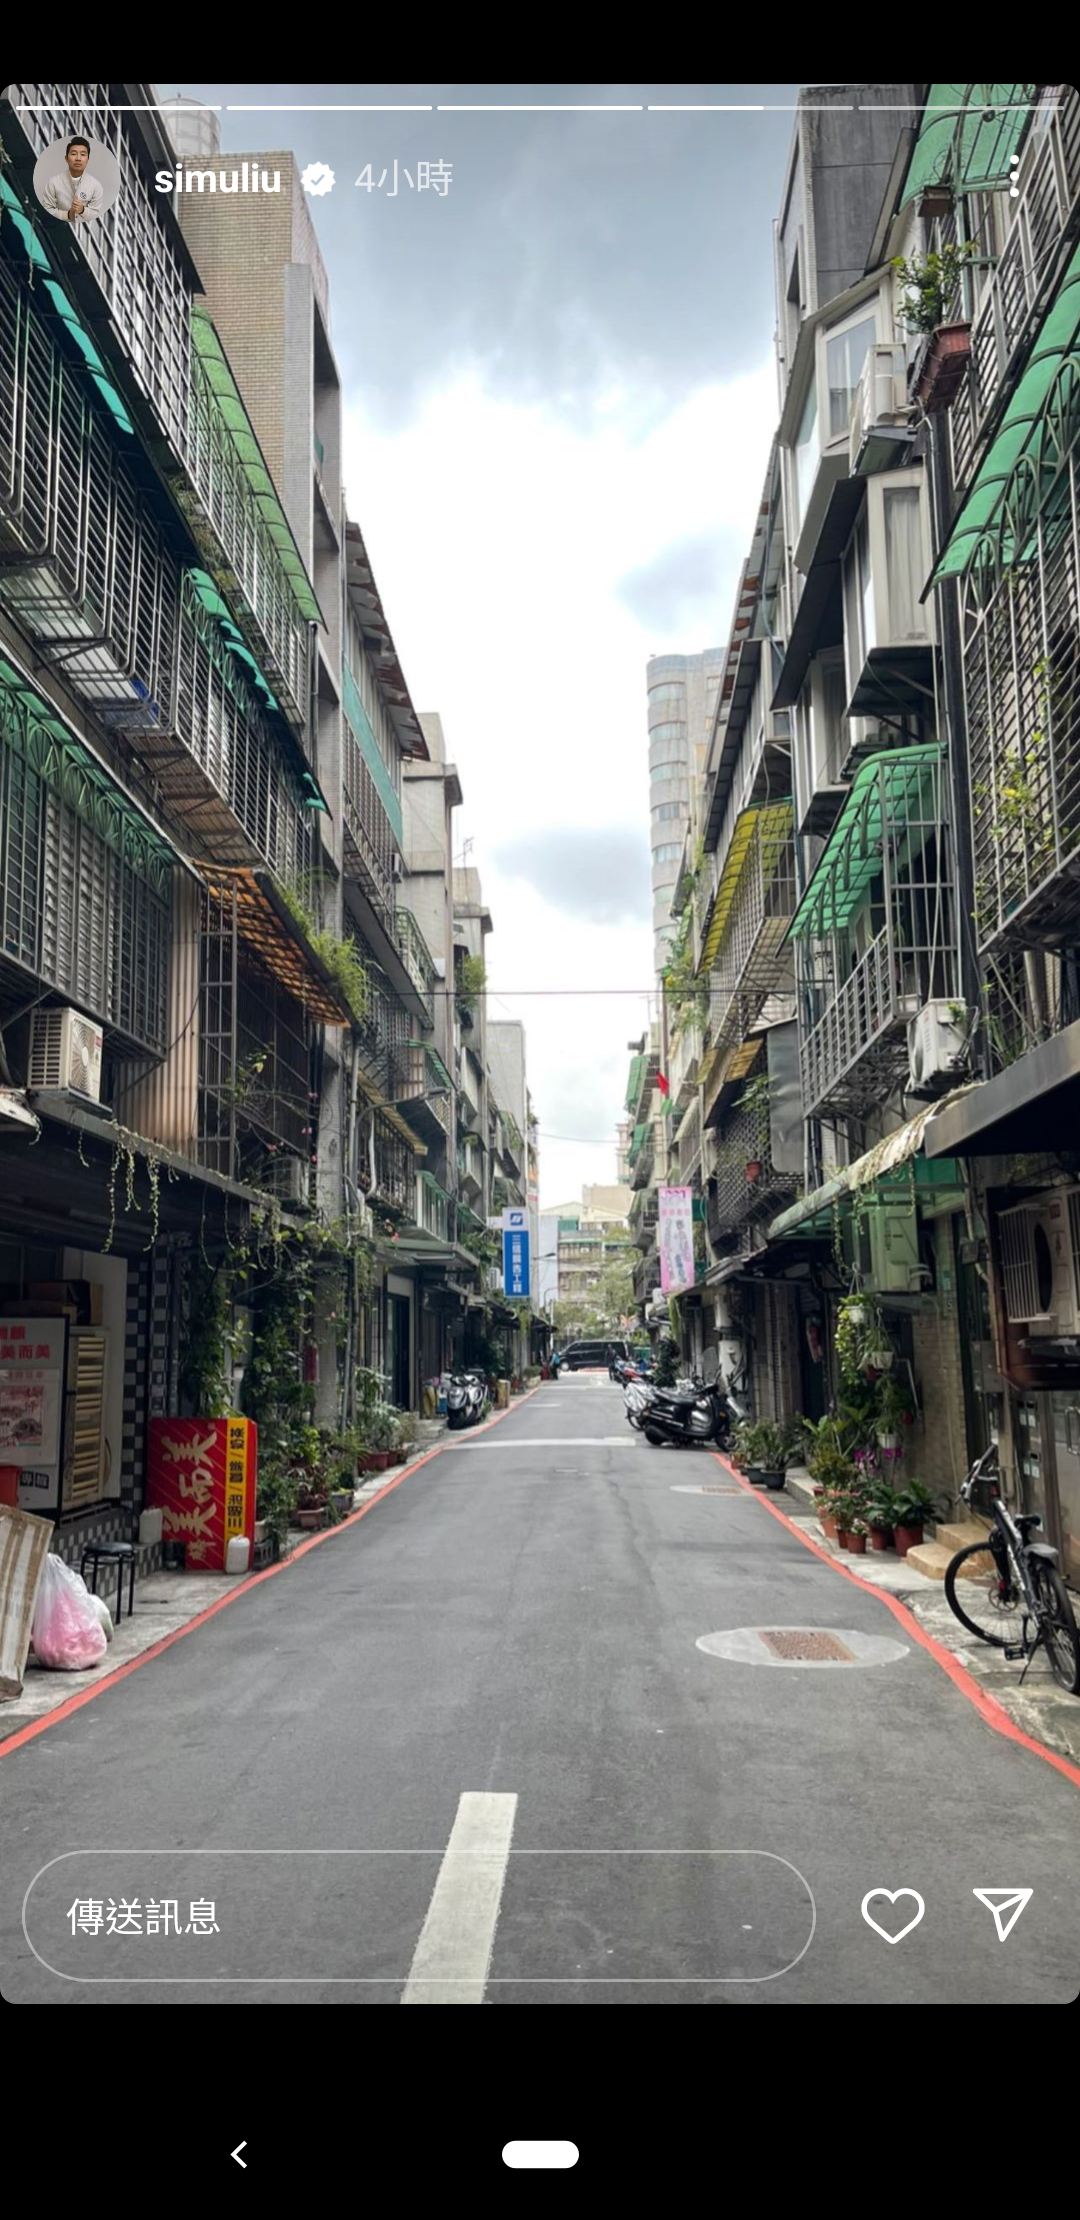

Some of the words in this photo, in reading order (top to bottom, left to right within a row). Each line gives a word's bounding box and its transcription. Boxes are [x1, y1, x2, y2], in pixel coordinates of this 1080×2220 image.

[1, 1344, 50, 1360] 美而美
[230, 1428, 245, 1450] 奶茶
[229, 1460, 244, 1483] 咖啡
[161, 1430, 218, 1538] 美而美
[227, 1494, 243, 1528] 三明治
